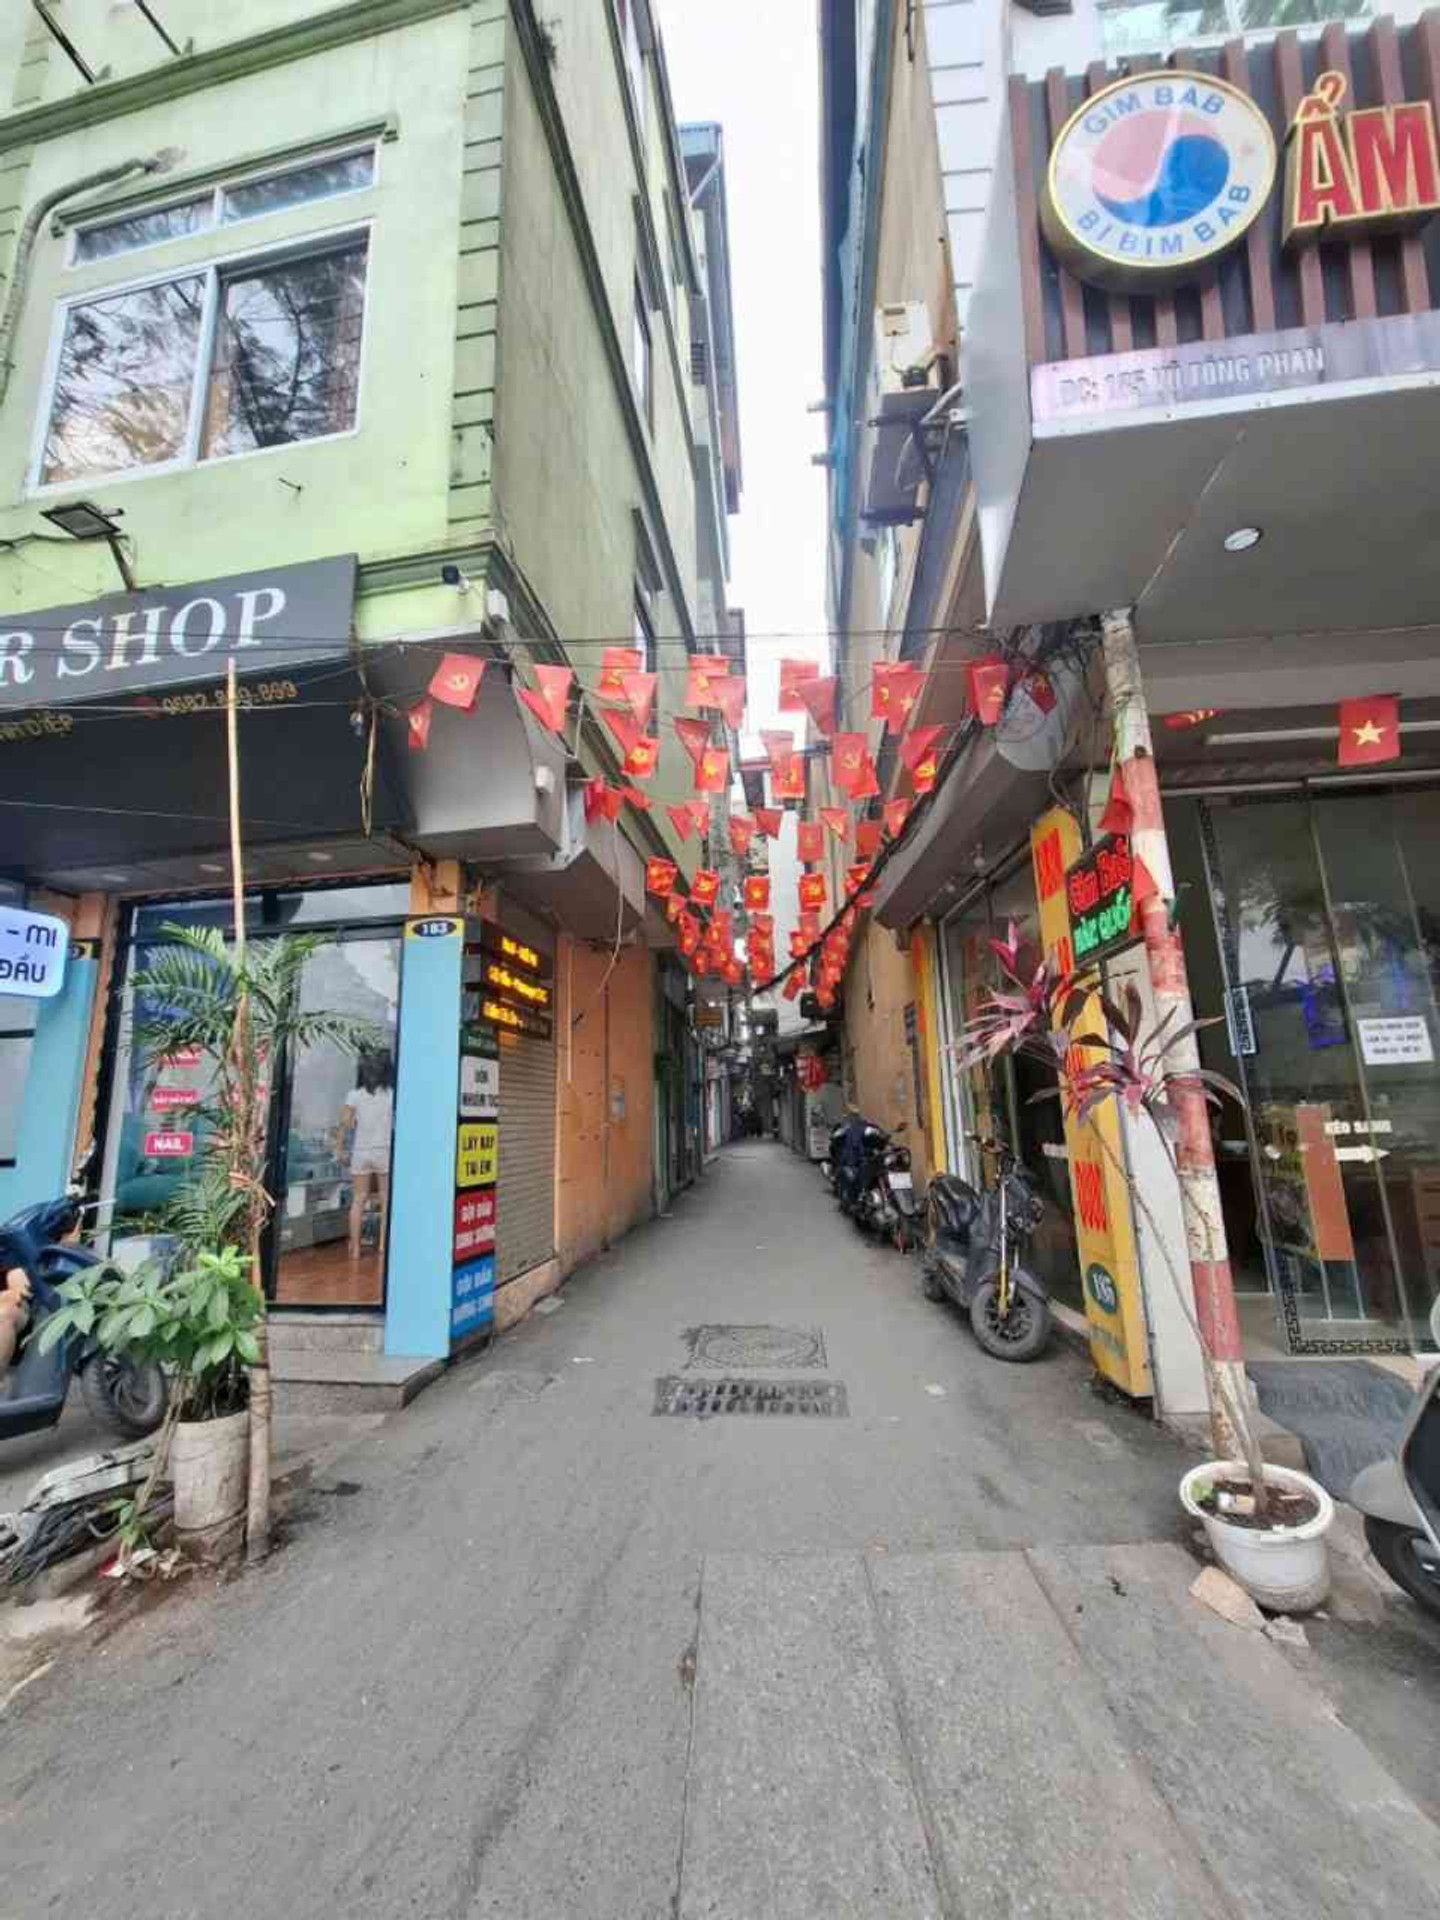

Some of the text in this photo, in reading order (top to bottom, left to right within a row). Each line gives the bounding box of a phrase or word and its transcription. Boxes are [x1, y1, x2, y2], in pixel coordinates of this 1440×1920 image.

[1083, 85, 1225, 135] GIM BAB
[1193, 184, 1252, 243] BAB
[57, 587, 287, 679] SHOP
